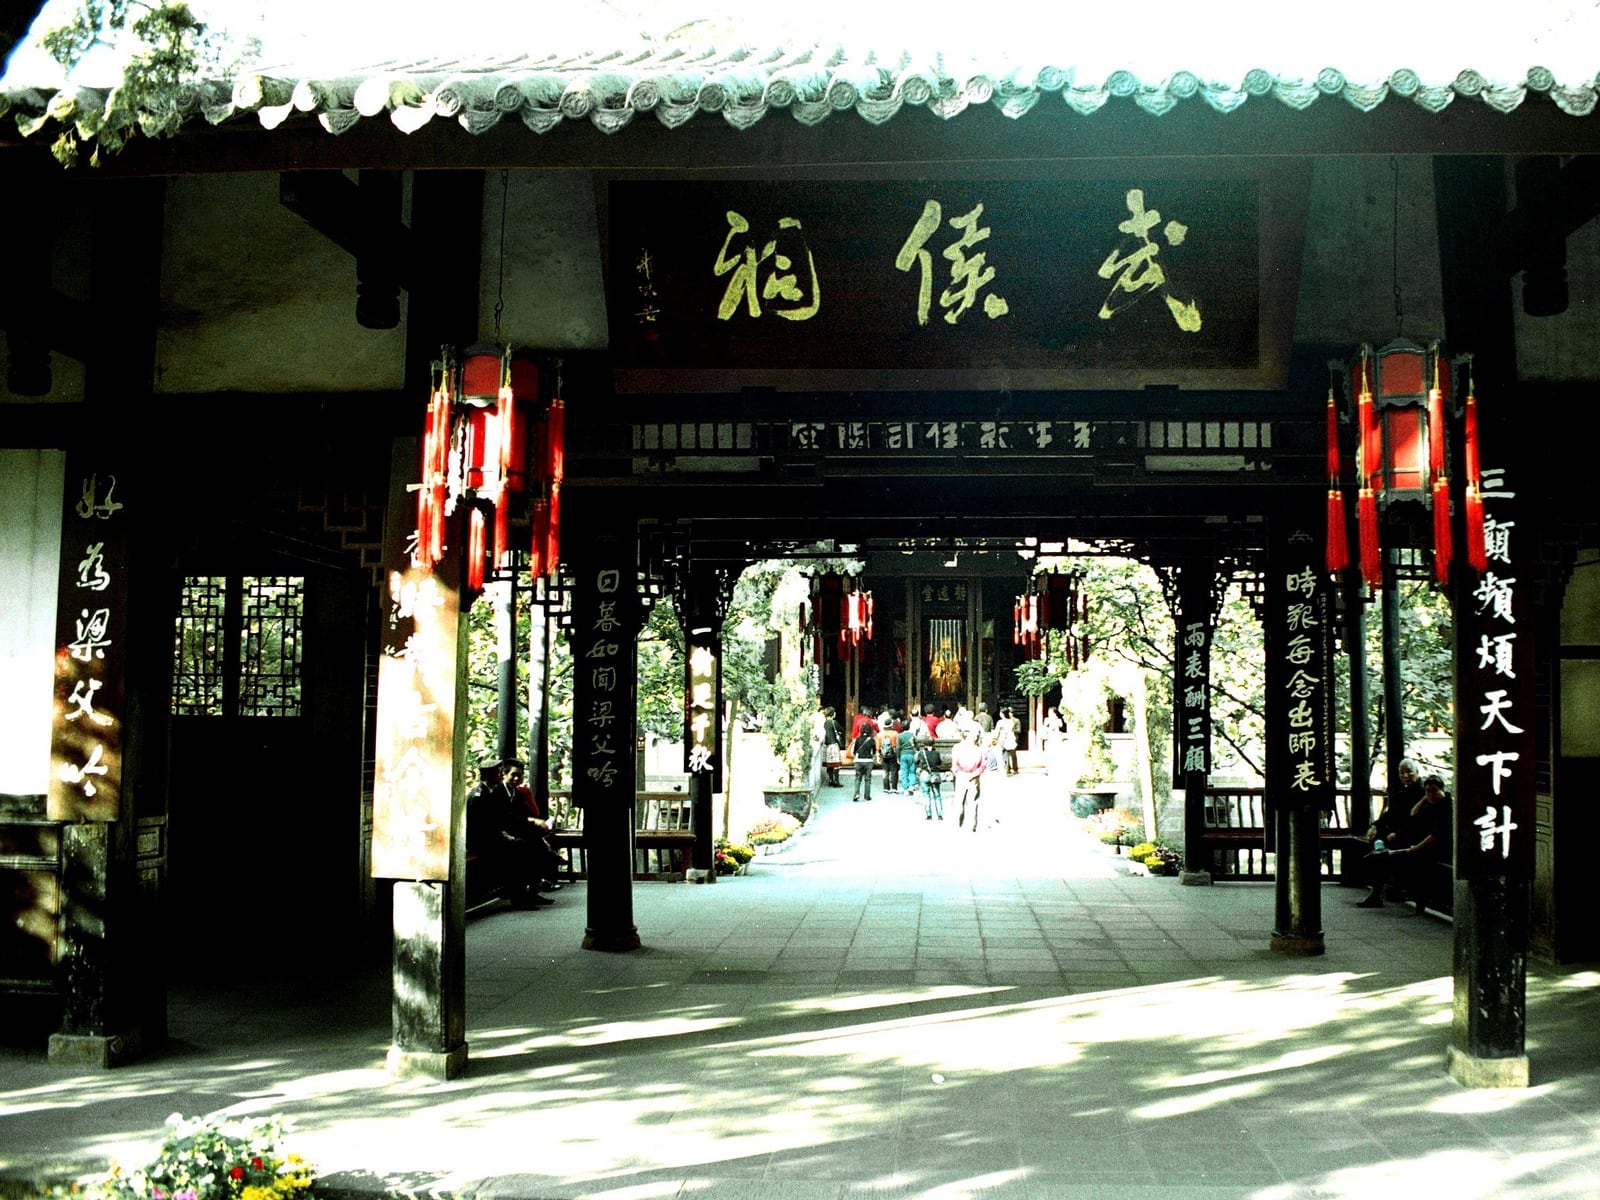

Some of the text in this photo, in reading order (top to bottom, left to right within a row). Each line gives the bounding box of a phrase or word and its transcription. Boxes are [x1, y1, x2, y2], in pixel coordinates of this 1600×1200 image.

[713, 189, 1202, 333] 武侯祠
[1472, 467, 1526, 860] 三顧頻煩天下計
